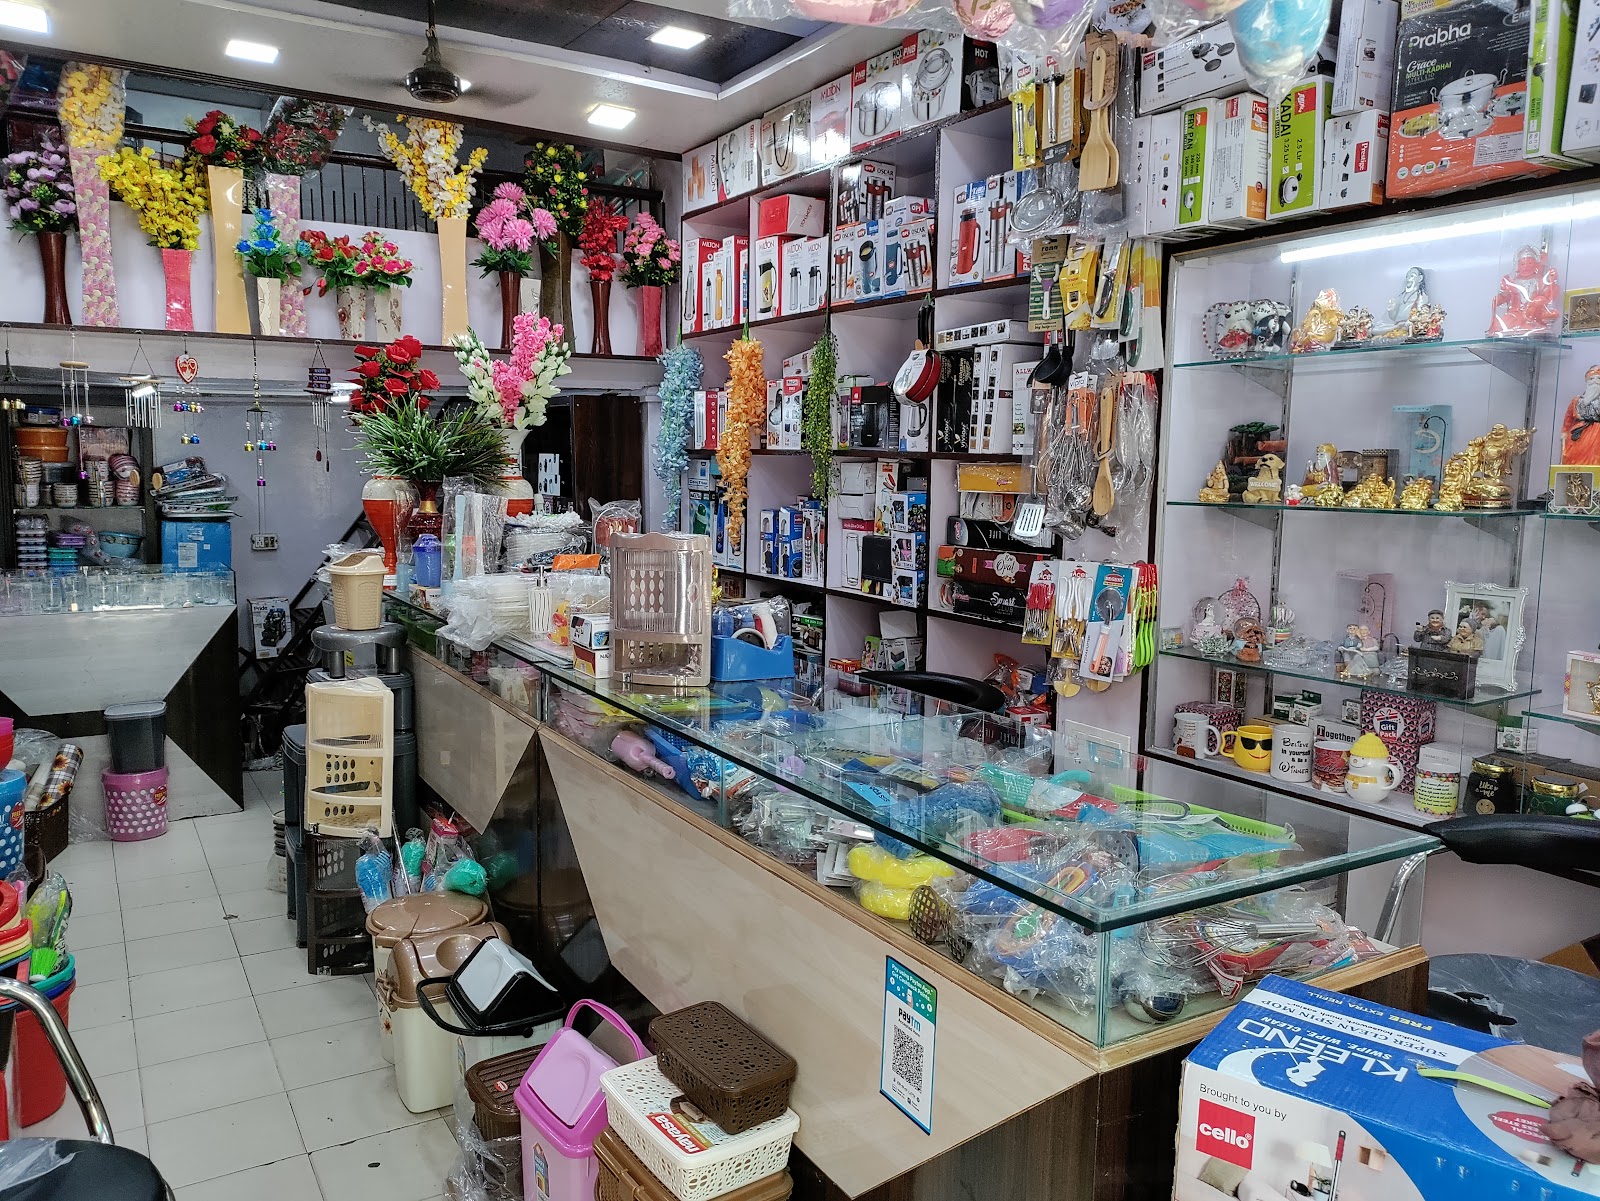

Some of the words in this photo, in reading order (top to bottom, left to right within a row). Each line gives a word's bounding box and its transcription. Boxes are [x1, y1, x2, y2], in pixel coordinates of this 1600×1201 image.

[1409, 23, 1472, 48] Prabha
[902, 44, 916, 57] PNB
[975, 48, 989, 58] HOT
[1406, 62, 1452, 79] MULTI-KADHAI
[1407, 58, 1438, 73] Grace
[855, 69, 865, 81] PNB
[820, 82, 841, 101] MILTON
[1060, 85, 1072, 139] lighter
[1281, 93, 1292, 137] KADAI
[1186, 133, 1194, 150] PAN
[1359, 142, 1369, 171] Prestige
[710, 154, 718, 192] MILTON
[702, 240, 720, 249] MILTON
[760, 239, 774, 249] MILTON
[787, 243, 802, 254] MILTON
[808, 243, 822, 252] MILTON
[1069, 379, 1085, 388] vipro
[1317, 724, 1356, 743] Together
[1380, 723, 1395, 731] Gift
[1307, 991, 1343, 1005] REFILL
[1261, 998, 1296, 1015] MOP
[1349, 1003, 1384, 1017] EXTRA
[1260, 1016, 1302, 1032] CLEAN
[1298, 1011, 1335, 1027] SPIN
[1320, 1011, 1343, 1021] much
[1388, 1015, 1433, 1031] FREE
[1306, 1029, 1342, 1045] WIPE.
[1337, 1024, 1389, 1041] CLEAN
[1236, 1018, 1409, 1082] KLEENO
[1346, 1042, 1392, 1060] SWIPE.
[1392, 1037, 1448, 1059] SUPER
[1199, 1083, 1238, 1104] Brought
[1241, 1097, 1250, 1107] to
[1253, 1103, 1271, 1115] you
[1274, 1108, 1287, 1121] by
[1492, 1115, 1520, 1127] STEEL
[1199, 1123, 1250, 1149] cello
